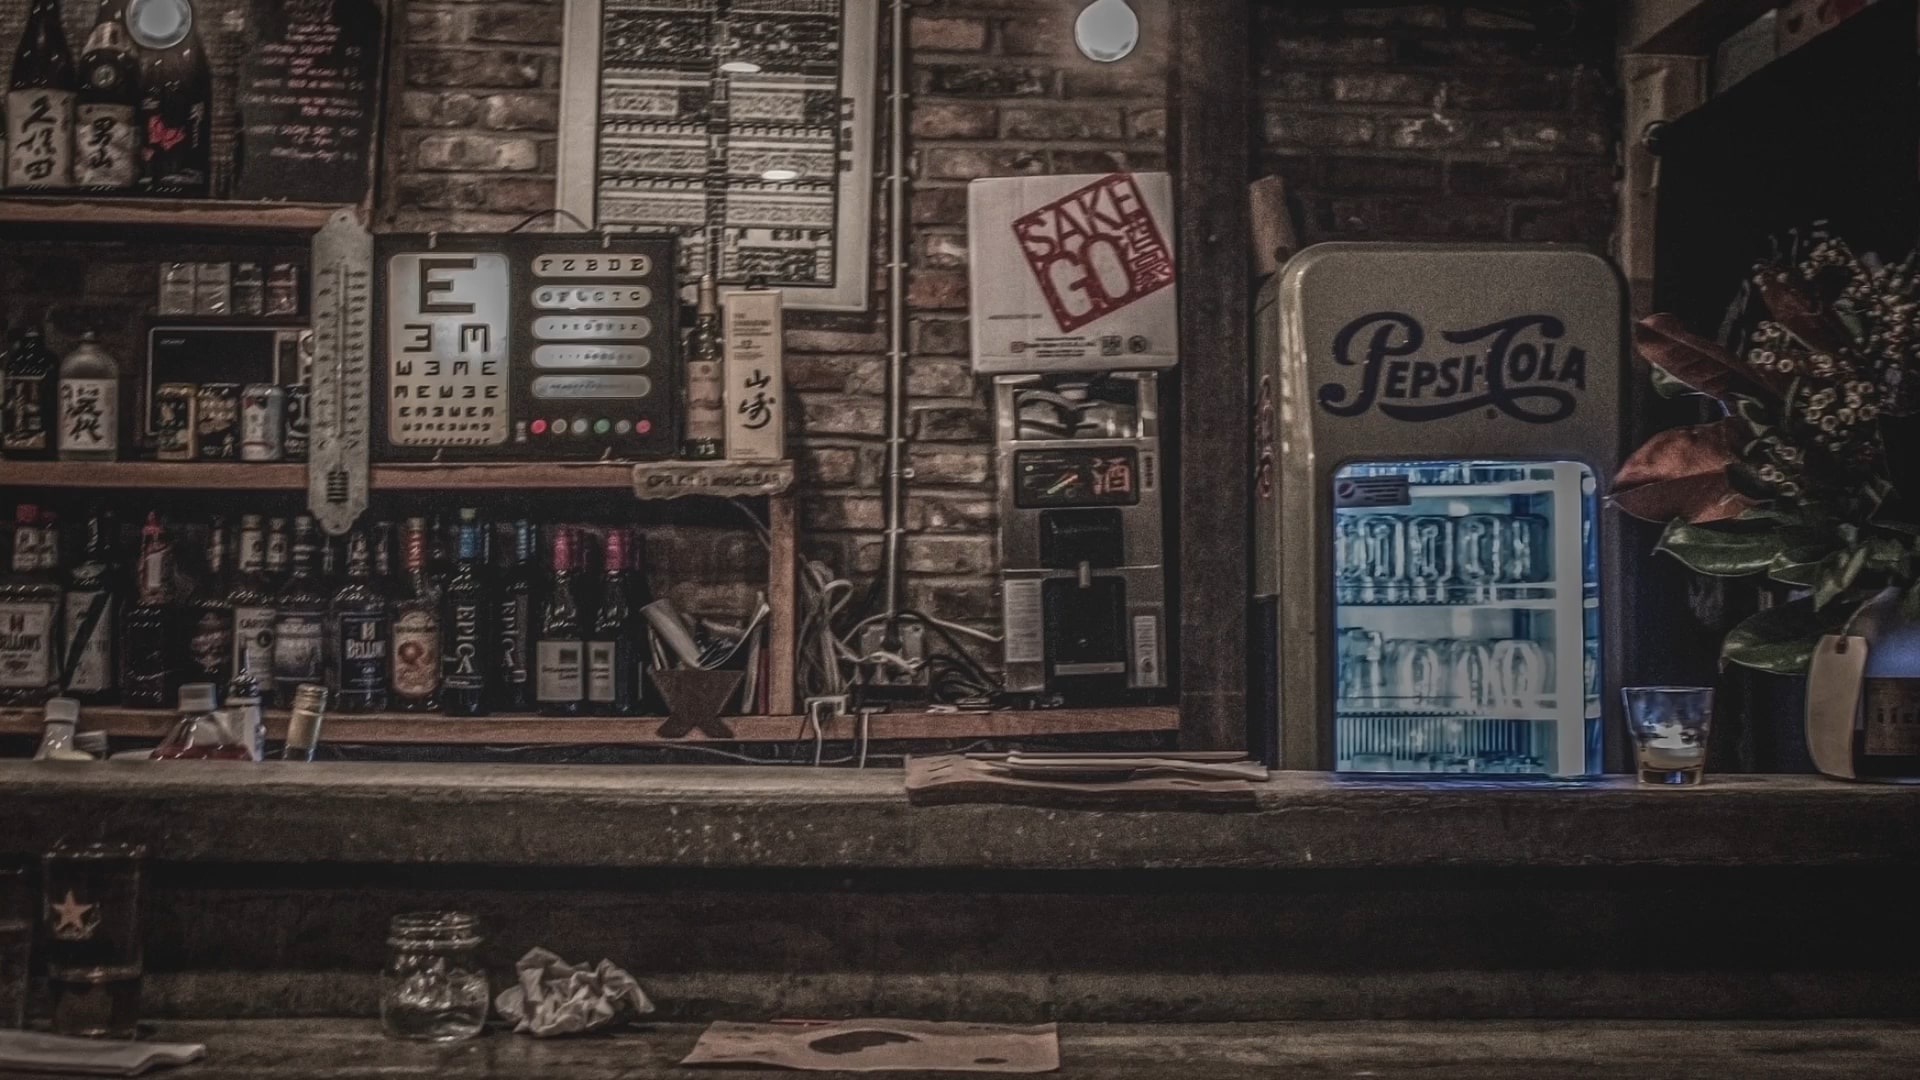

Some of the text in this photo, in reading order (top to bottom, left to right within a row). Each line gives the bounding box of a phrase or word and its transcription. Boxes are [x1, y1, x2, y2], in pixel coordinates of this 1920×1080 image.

[17, 95, 58, 182] 久保田
[1016, 174, 1144, 258] SAKE
[419, 258, 477, 314] E
[1040, 233, 1135, 322] GO
[738, 369, 776, 430] 山崎
[1090, 457, 1131, 495] 酒
